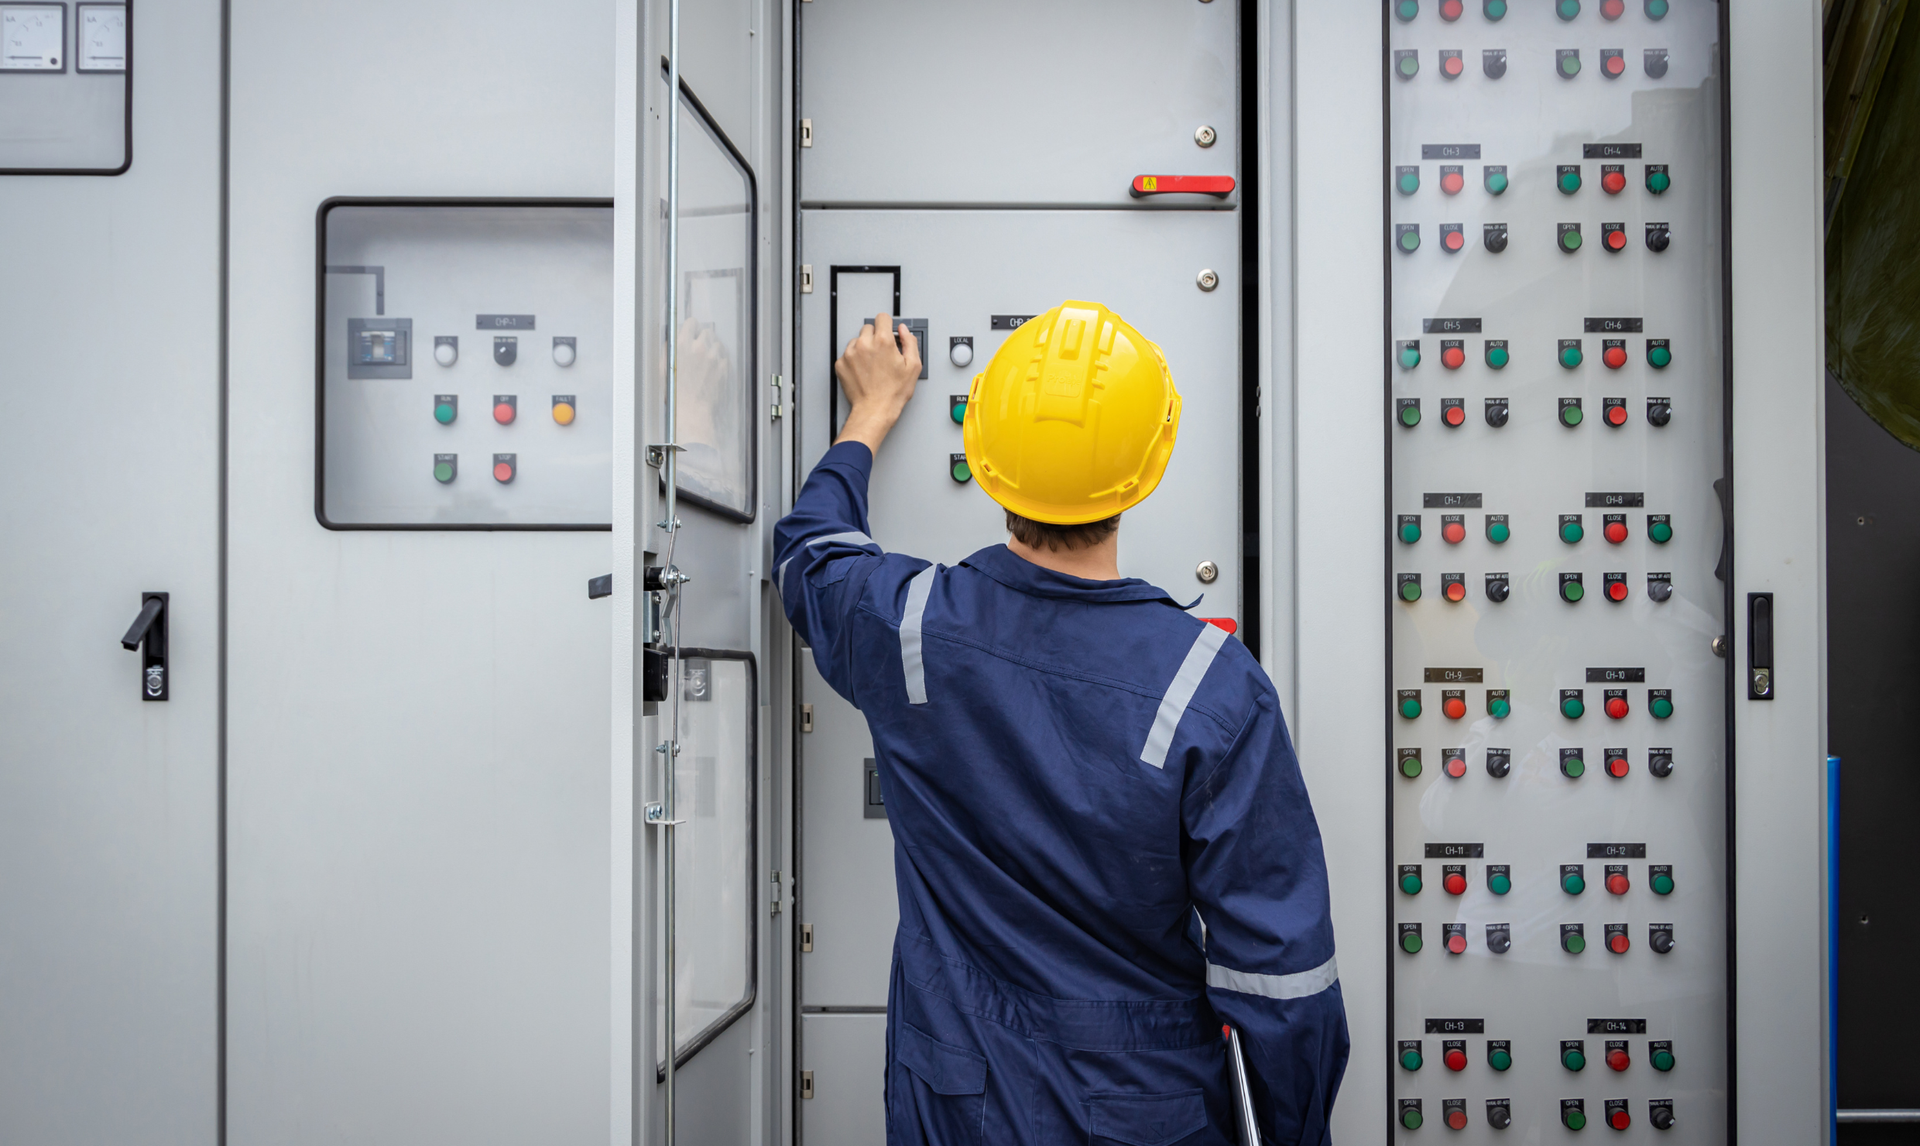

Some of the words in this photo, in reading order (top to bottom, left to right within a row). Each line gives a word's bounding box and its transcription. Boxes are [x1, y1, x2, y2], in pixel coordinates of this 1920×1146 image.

[1442, 147, 1460, 156] CH-3
[1604, 146, 1621, 156] CH-4
[495, 318, 516, 327] CHP-1
[1444, 321, 1461, 330] CH-5
[1604, 320, 1622, 330] CH-6
[1444, 496, 1461, 505] CH-7
[1606, 495, 1623, 505] CH-8
[1445, 670, 1462, 680] CH-9
[1606, 670, 1625, 680] CH-10
[1445, 846, 1464, 855] CH-11
[1606, 846, 1626, 855] CH-12
[1444, 1021, 1465, 1031] CH-13
[1607, 1021, 1627, 1031] CH-14
